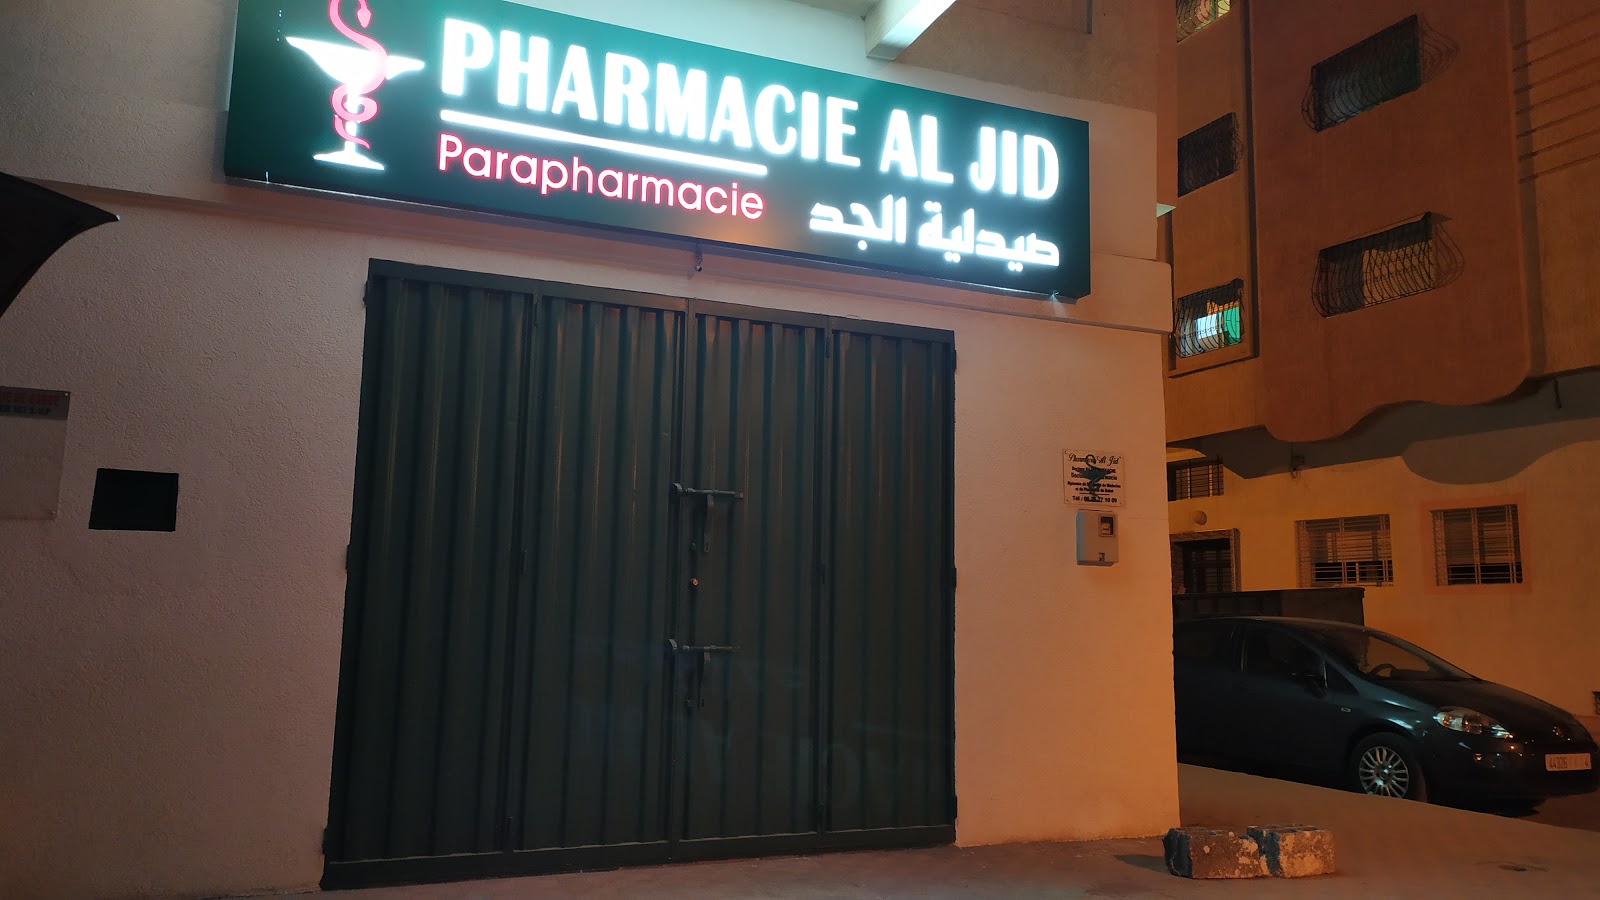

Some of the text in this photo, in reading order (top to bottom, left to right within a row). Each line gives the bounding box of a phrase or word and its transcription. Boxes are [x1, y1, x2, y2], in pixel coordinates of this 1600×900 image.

[441, 17, 1060, 200] PHARMACIE AL JID
[438, 132, 764, 220] Parapharmacie
[809, 193, 1060, 272] صيدلية الجد
